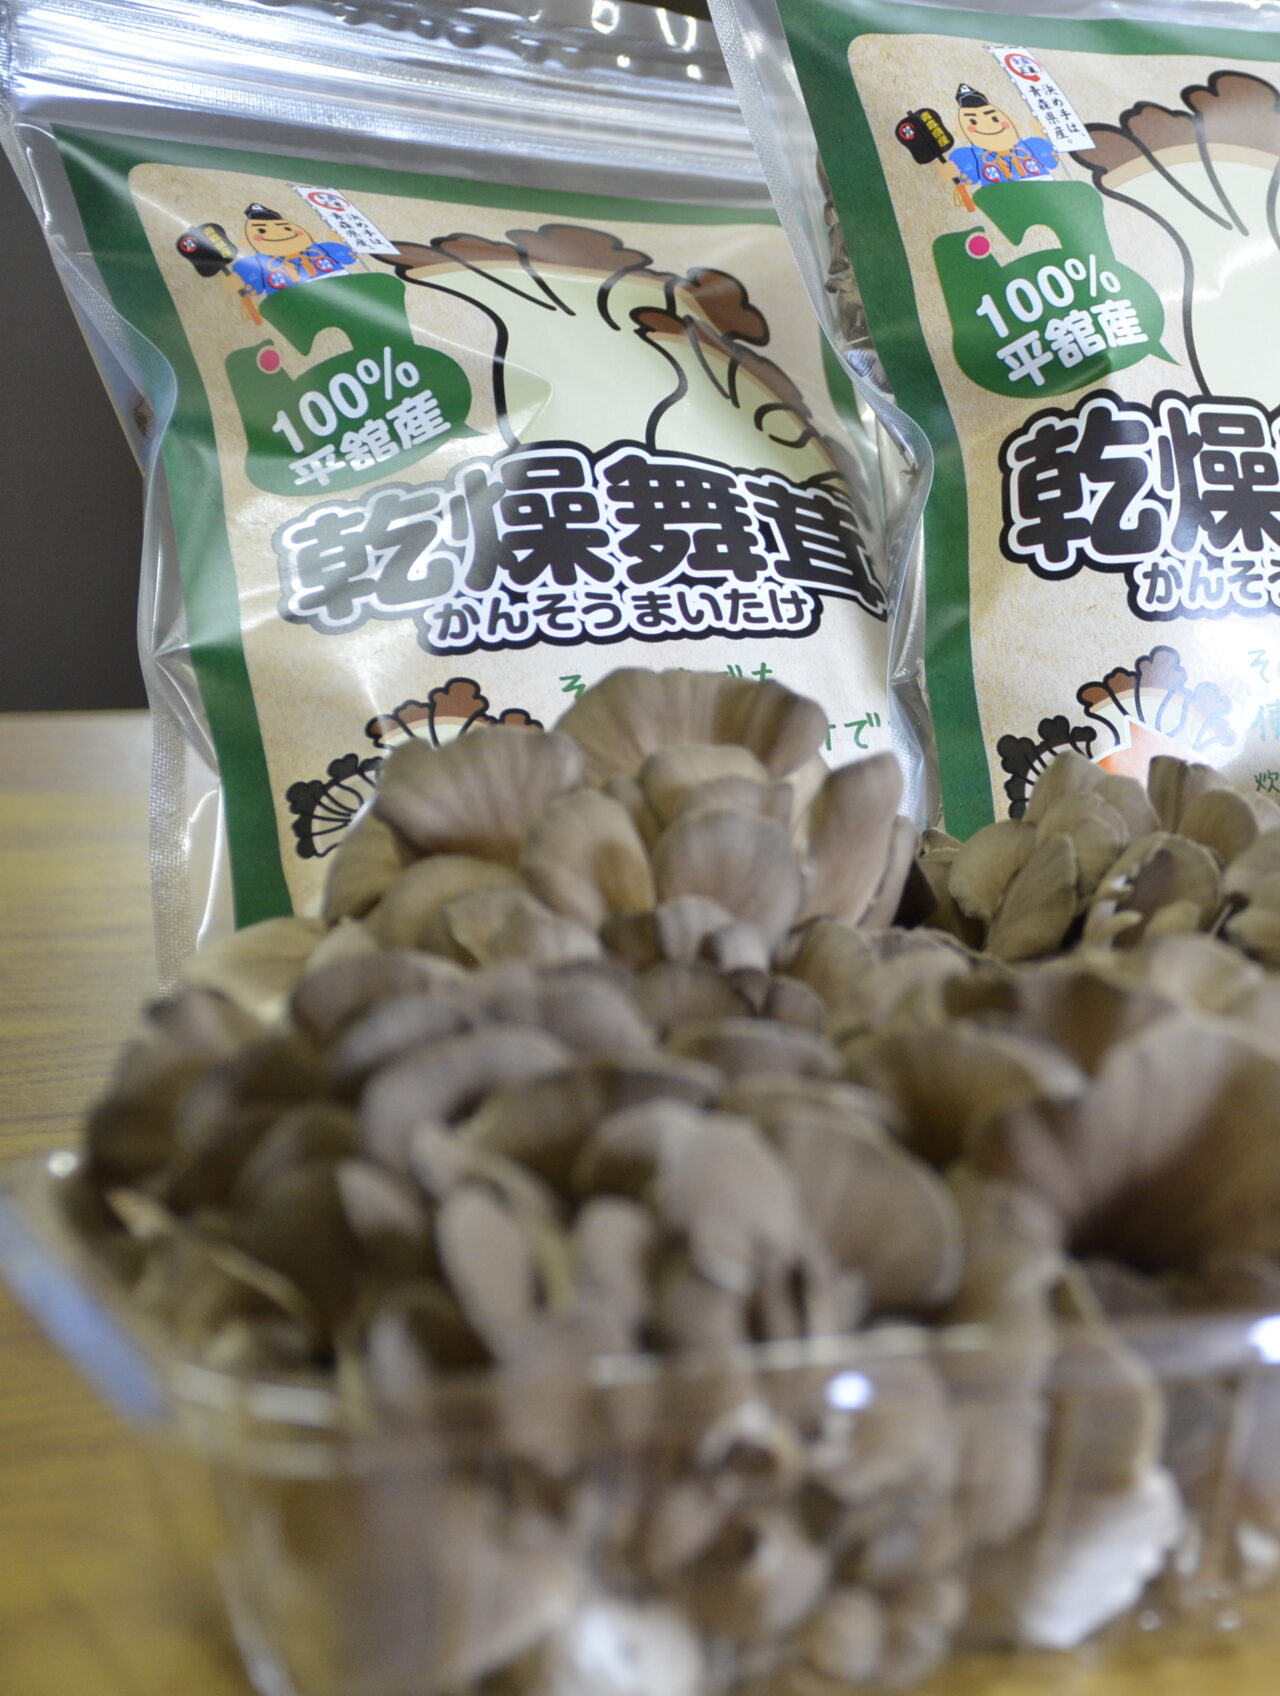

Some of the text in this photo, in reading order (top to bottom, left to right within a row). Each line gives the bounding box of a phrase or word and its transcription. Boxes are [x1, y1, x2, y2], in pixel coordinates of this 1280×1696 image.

[976, 254, 1121, 338] 100%
[272, 346, 420, 453] 100%
[297, 455, 886, 615] 乾燥舞茸
[433, 588, 808, 641] かんそうまいたけ
